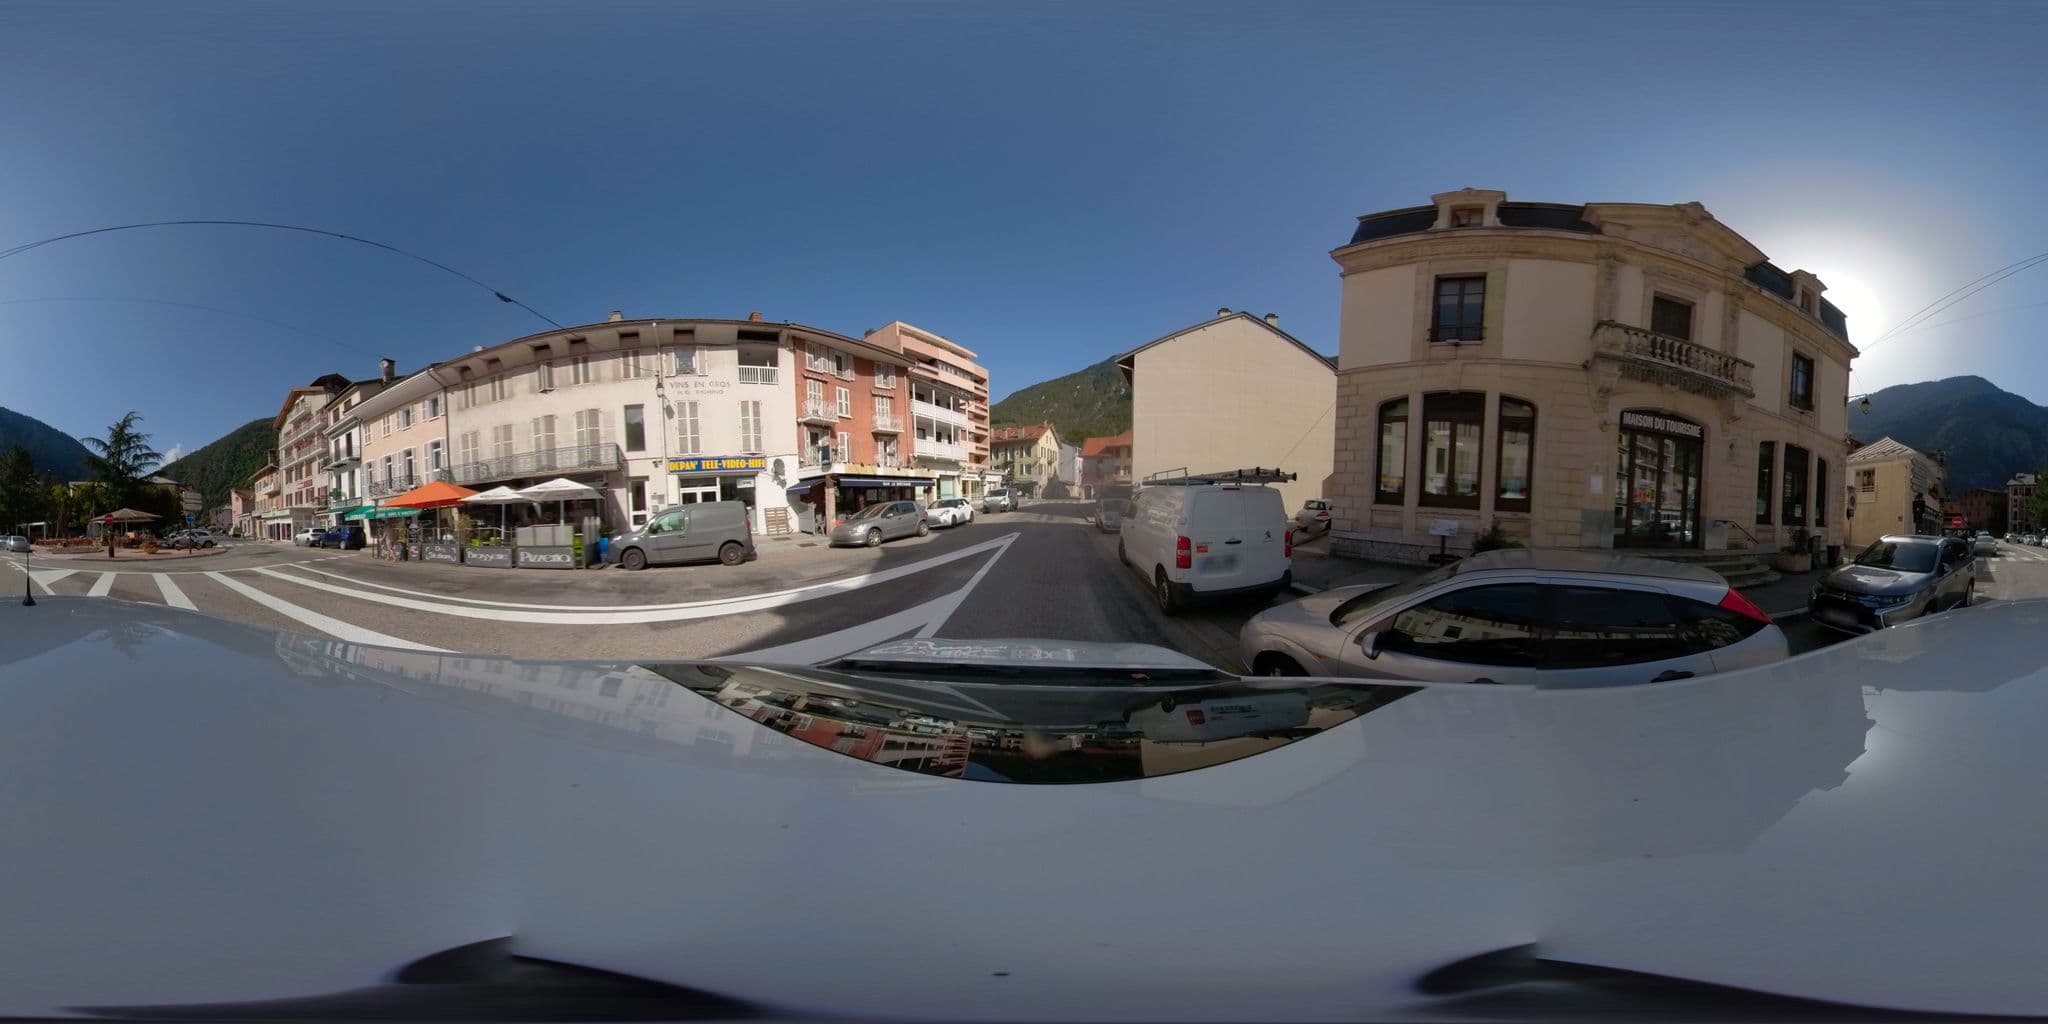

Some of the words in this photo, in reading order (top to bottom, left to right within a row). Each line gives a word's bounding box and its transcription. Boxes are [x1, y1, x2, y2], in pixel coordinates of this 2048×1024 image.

[1623, 412, 1654, 428] MAISON
[1654, 417, 1665, 430] DU
[1666, 420, 1701, 437] TOURISME
